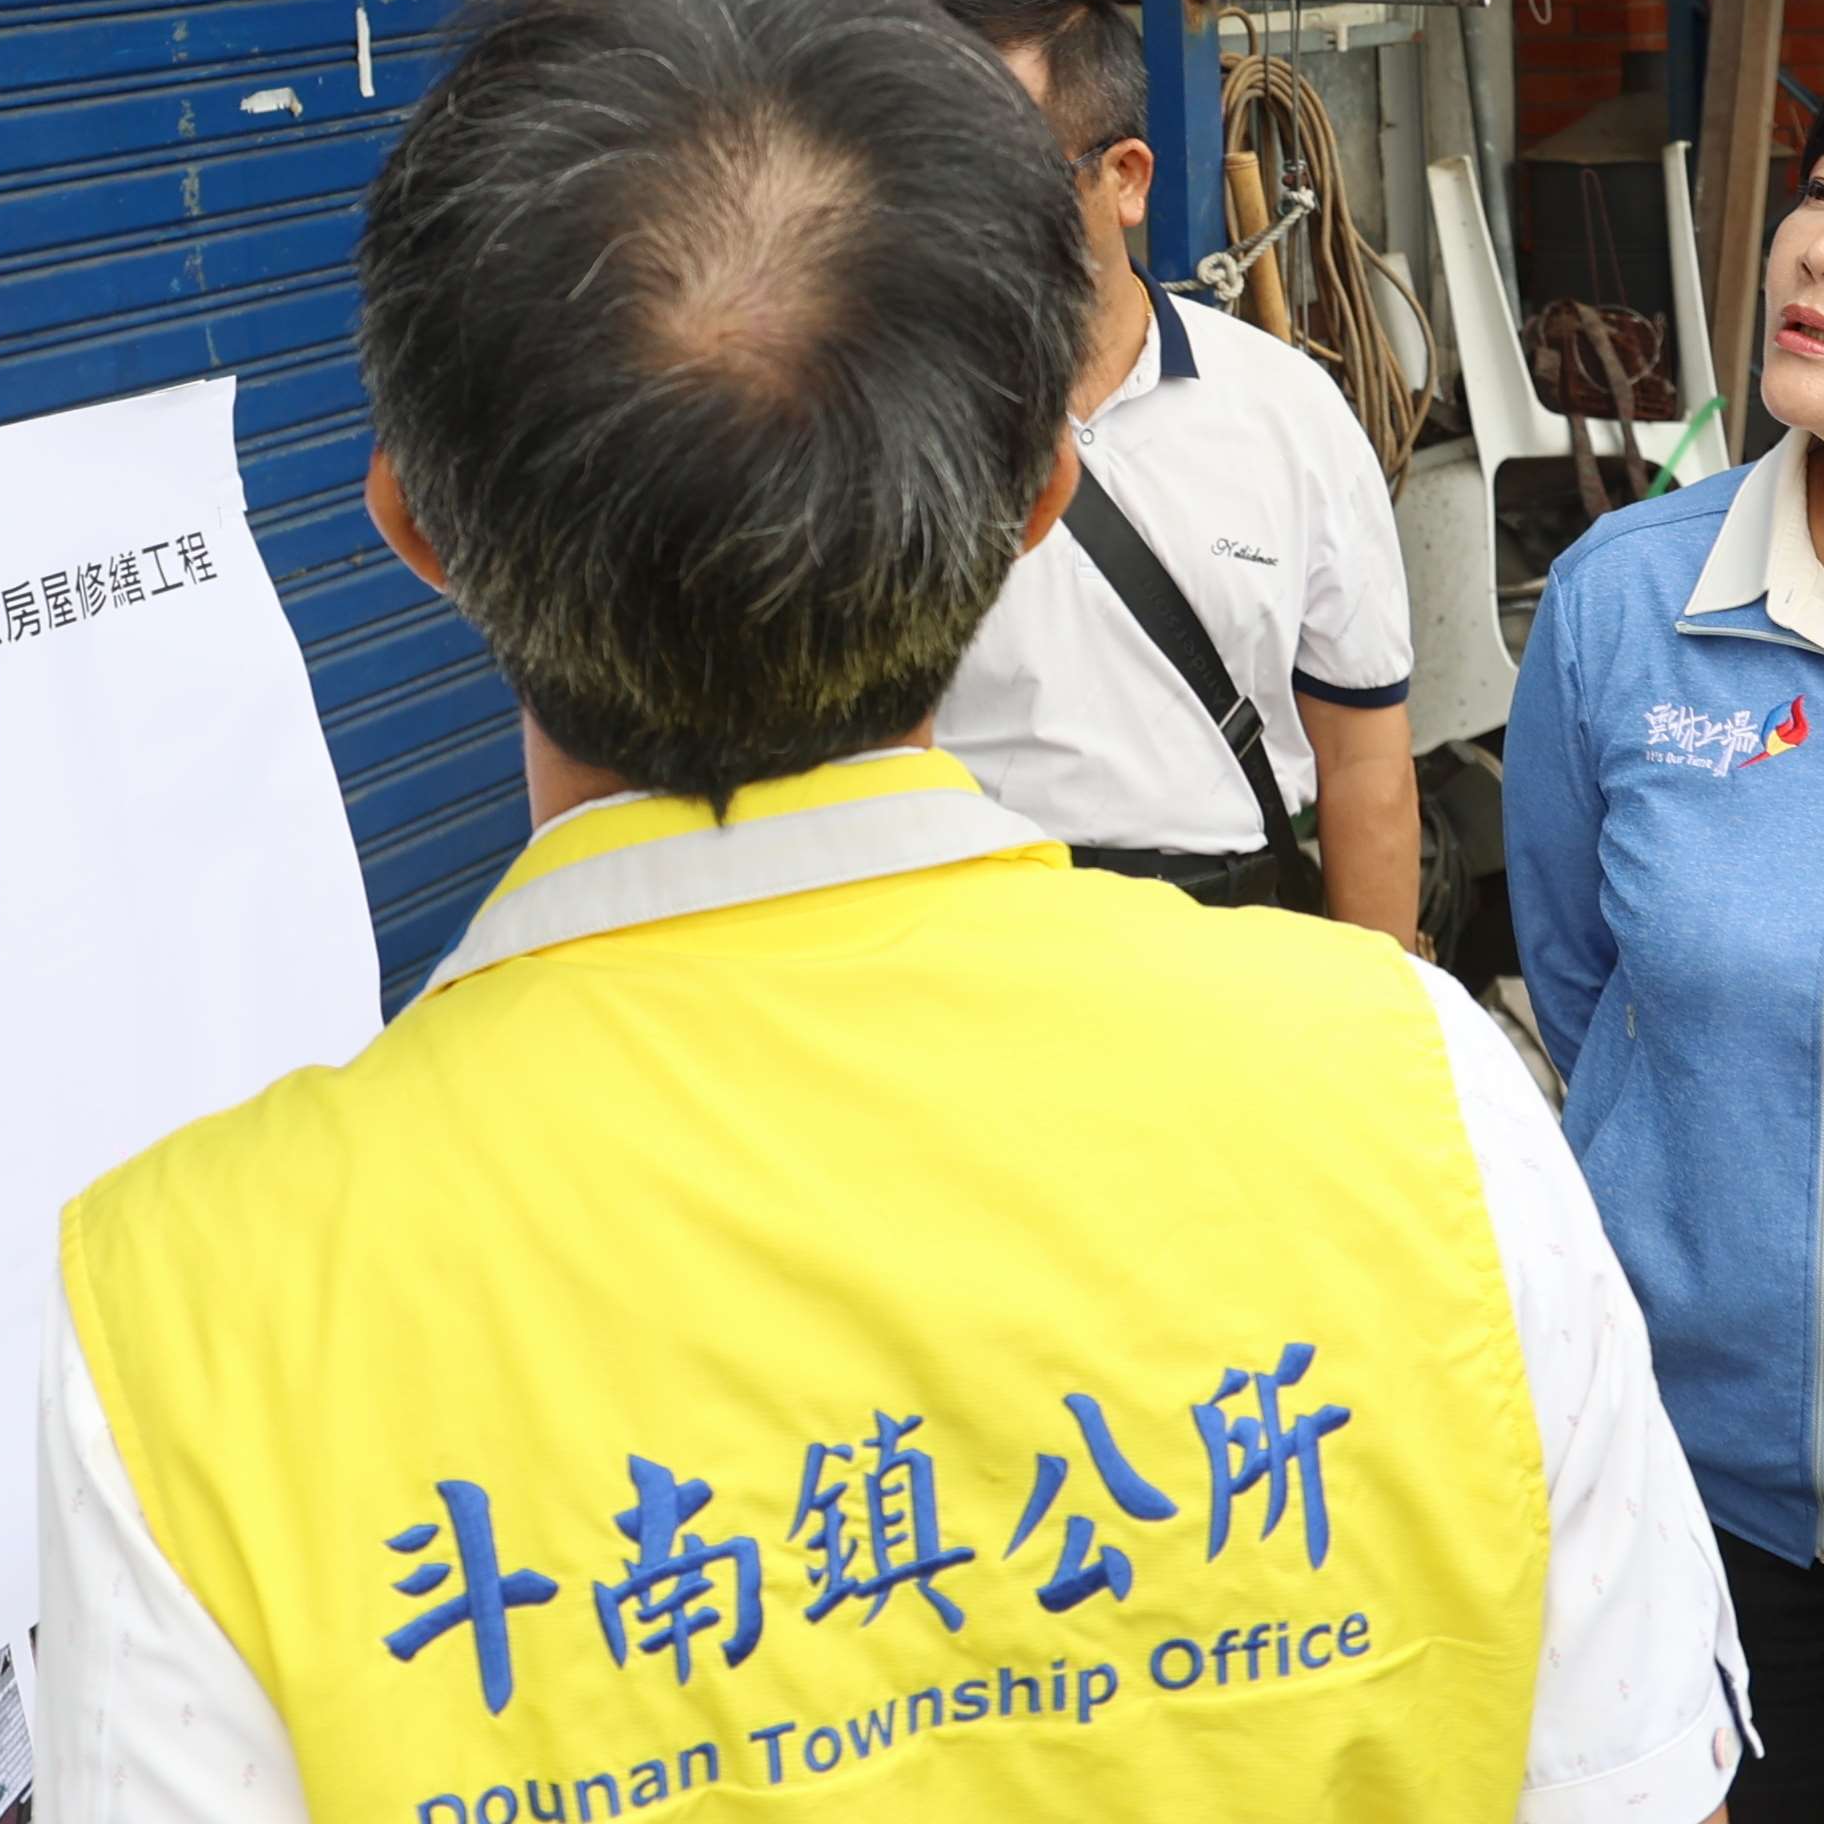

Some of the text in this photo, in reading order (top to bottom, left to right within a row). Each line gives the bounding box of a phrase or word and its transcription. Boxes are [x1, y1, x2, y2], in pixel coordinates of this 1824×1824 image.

[385, 1344, 1349, 1712] 斗南鎮公所
[752, 1662, 1117, 1782] Township
[1152, 1613, 1368, 1688] Office
